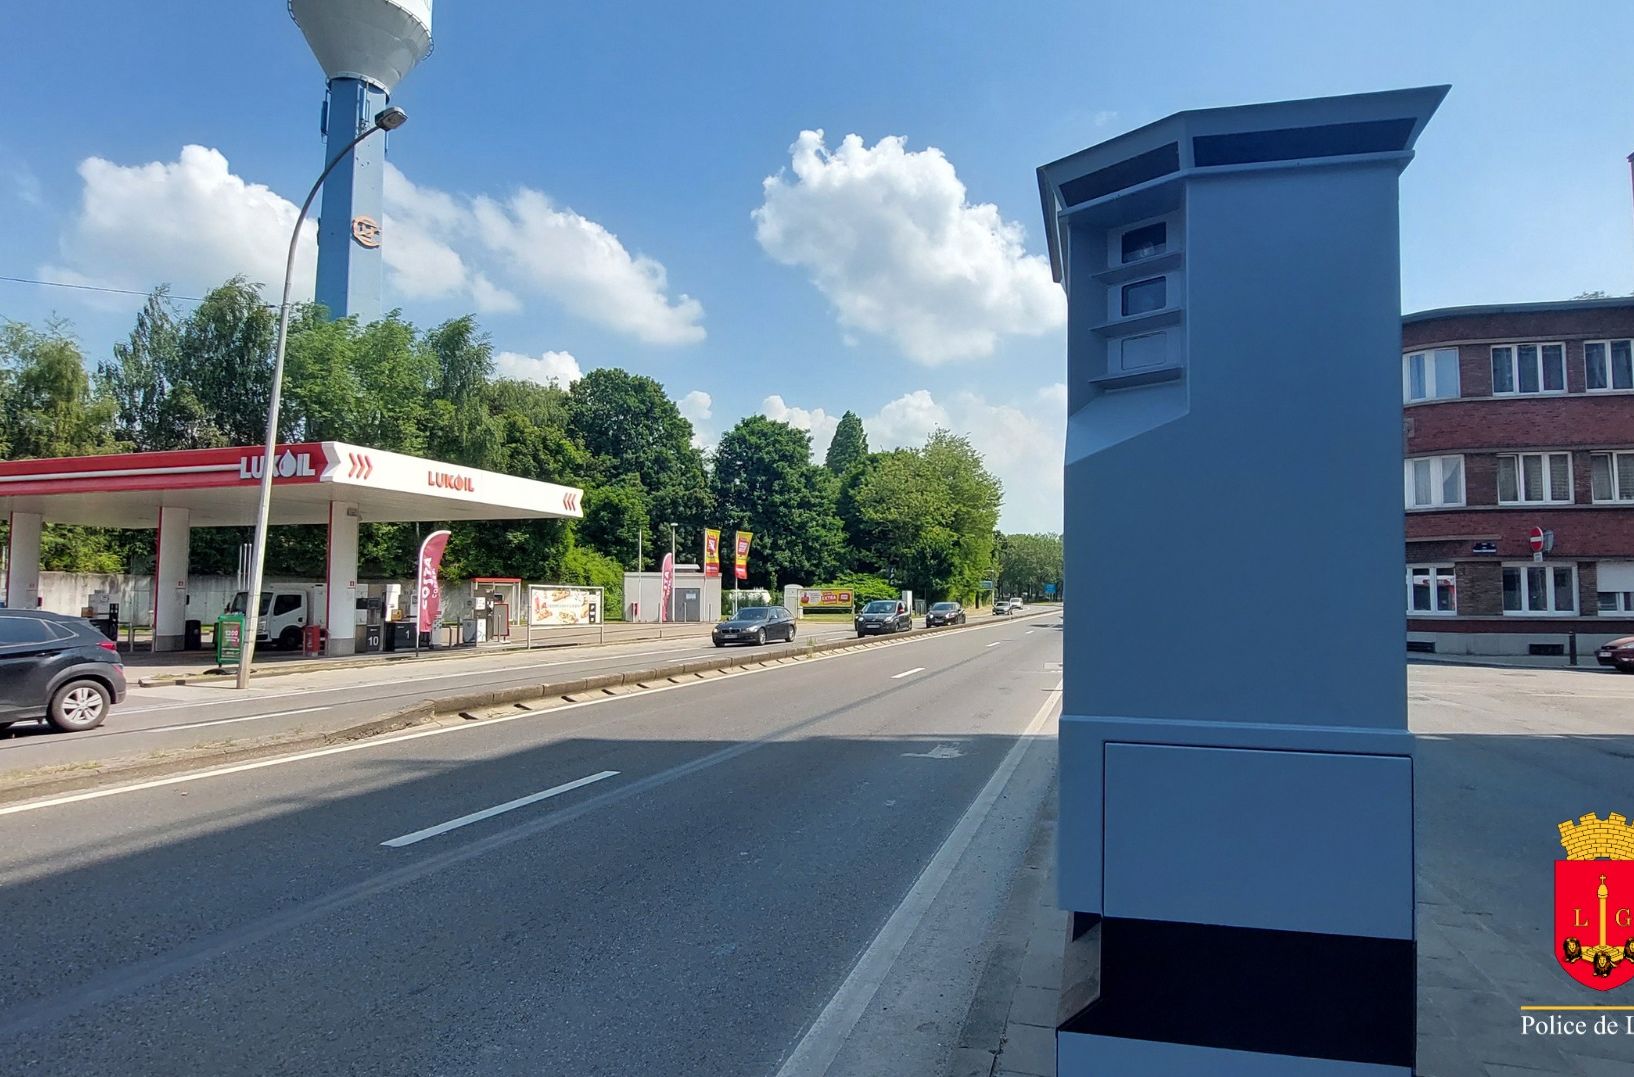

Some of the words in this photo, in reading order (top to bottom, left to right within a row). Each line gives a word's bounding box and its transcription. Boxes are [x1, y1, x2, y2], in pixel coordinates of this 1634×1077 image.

[428, 470, 475, 492] LUKOIL
[421, 557, 433, 610] COSTA
[368, 636, 379, 646] 10
[405, 629, 410, 639] 1
